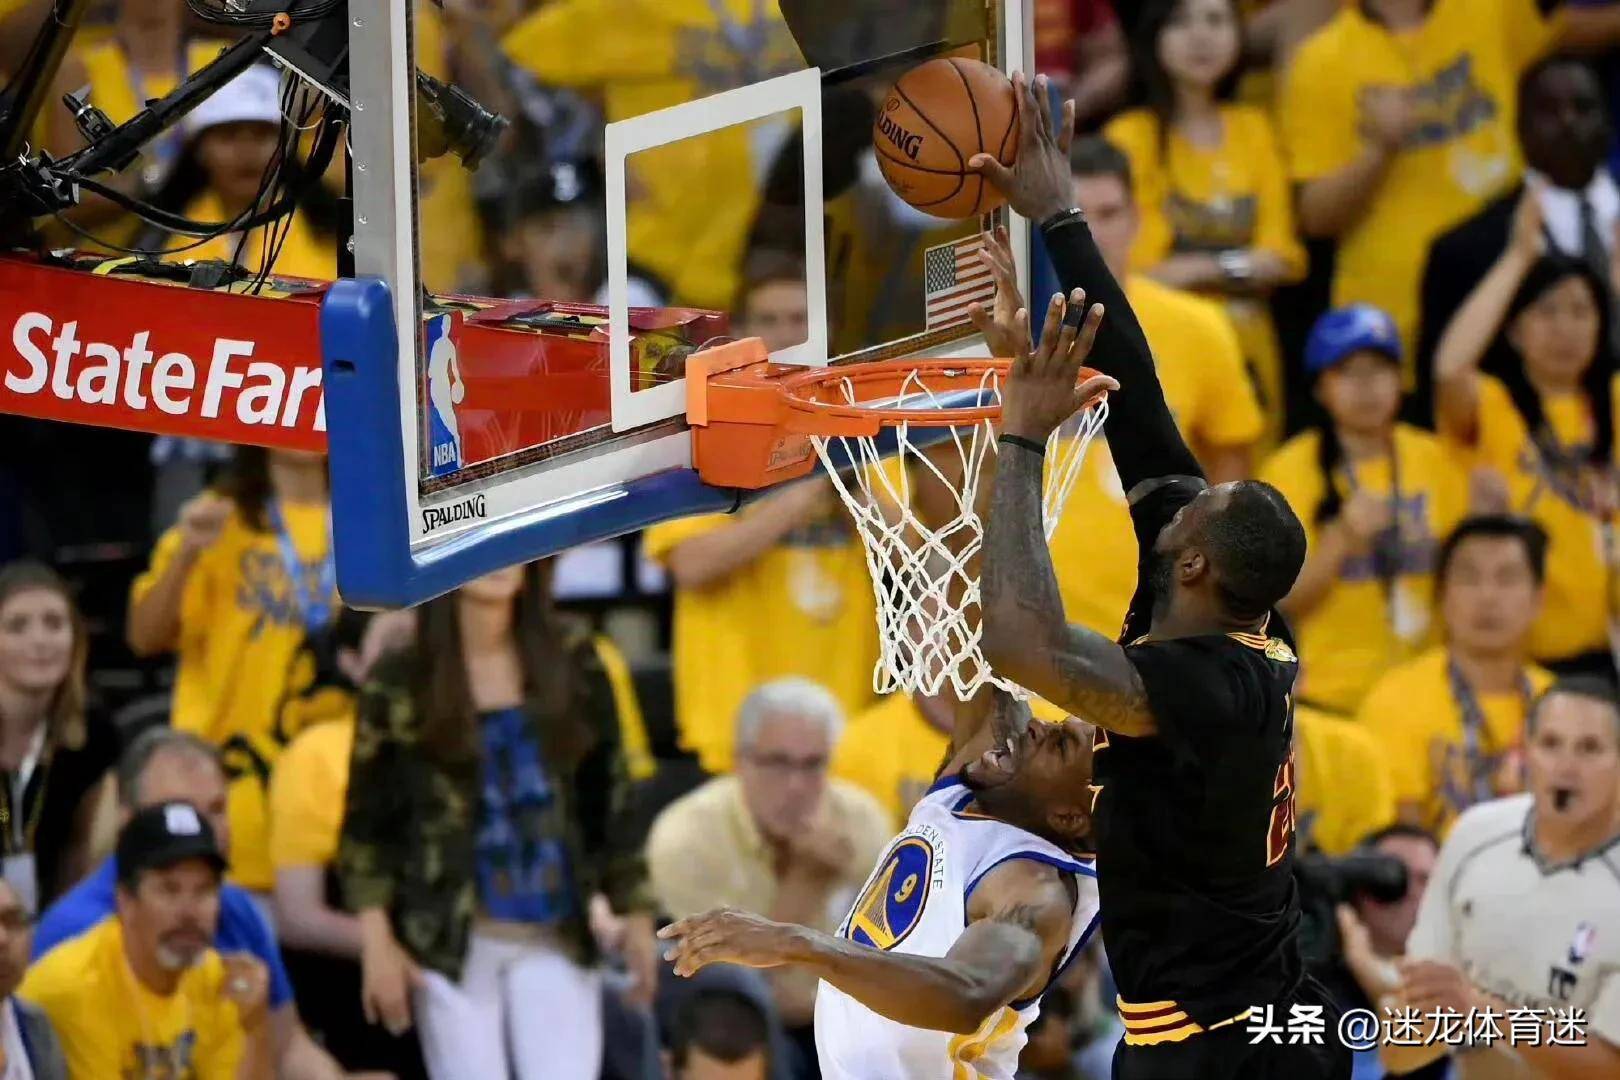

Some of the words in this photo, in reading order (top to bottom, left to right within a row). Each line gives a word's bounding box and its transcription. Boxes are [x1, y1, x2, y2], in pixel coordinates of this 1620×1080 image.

[200, 337, 327, 431] Far
[434, 441, 457, 467] NBA
[422, 494, 487, 534] SPALDING
[933, 841, 944, 889] STATE
[894, 873, 918, 903] 9
